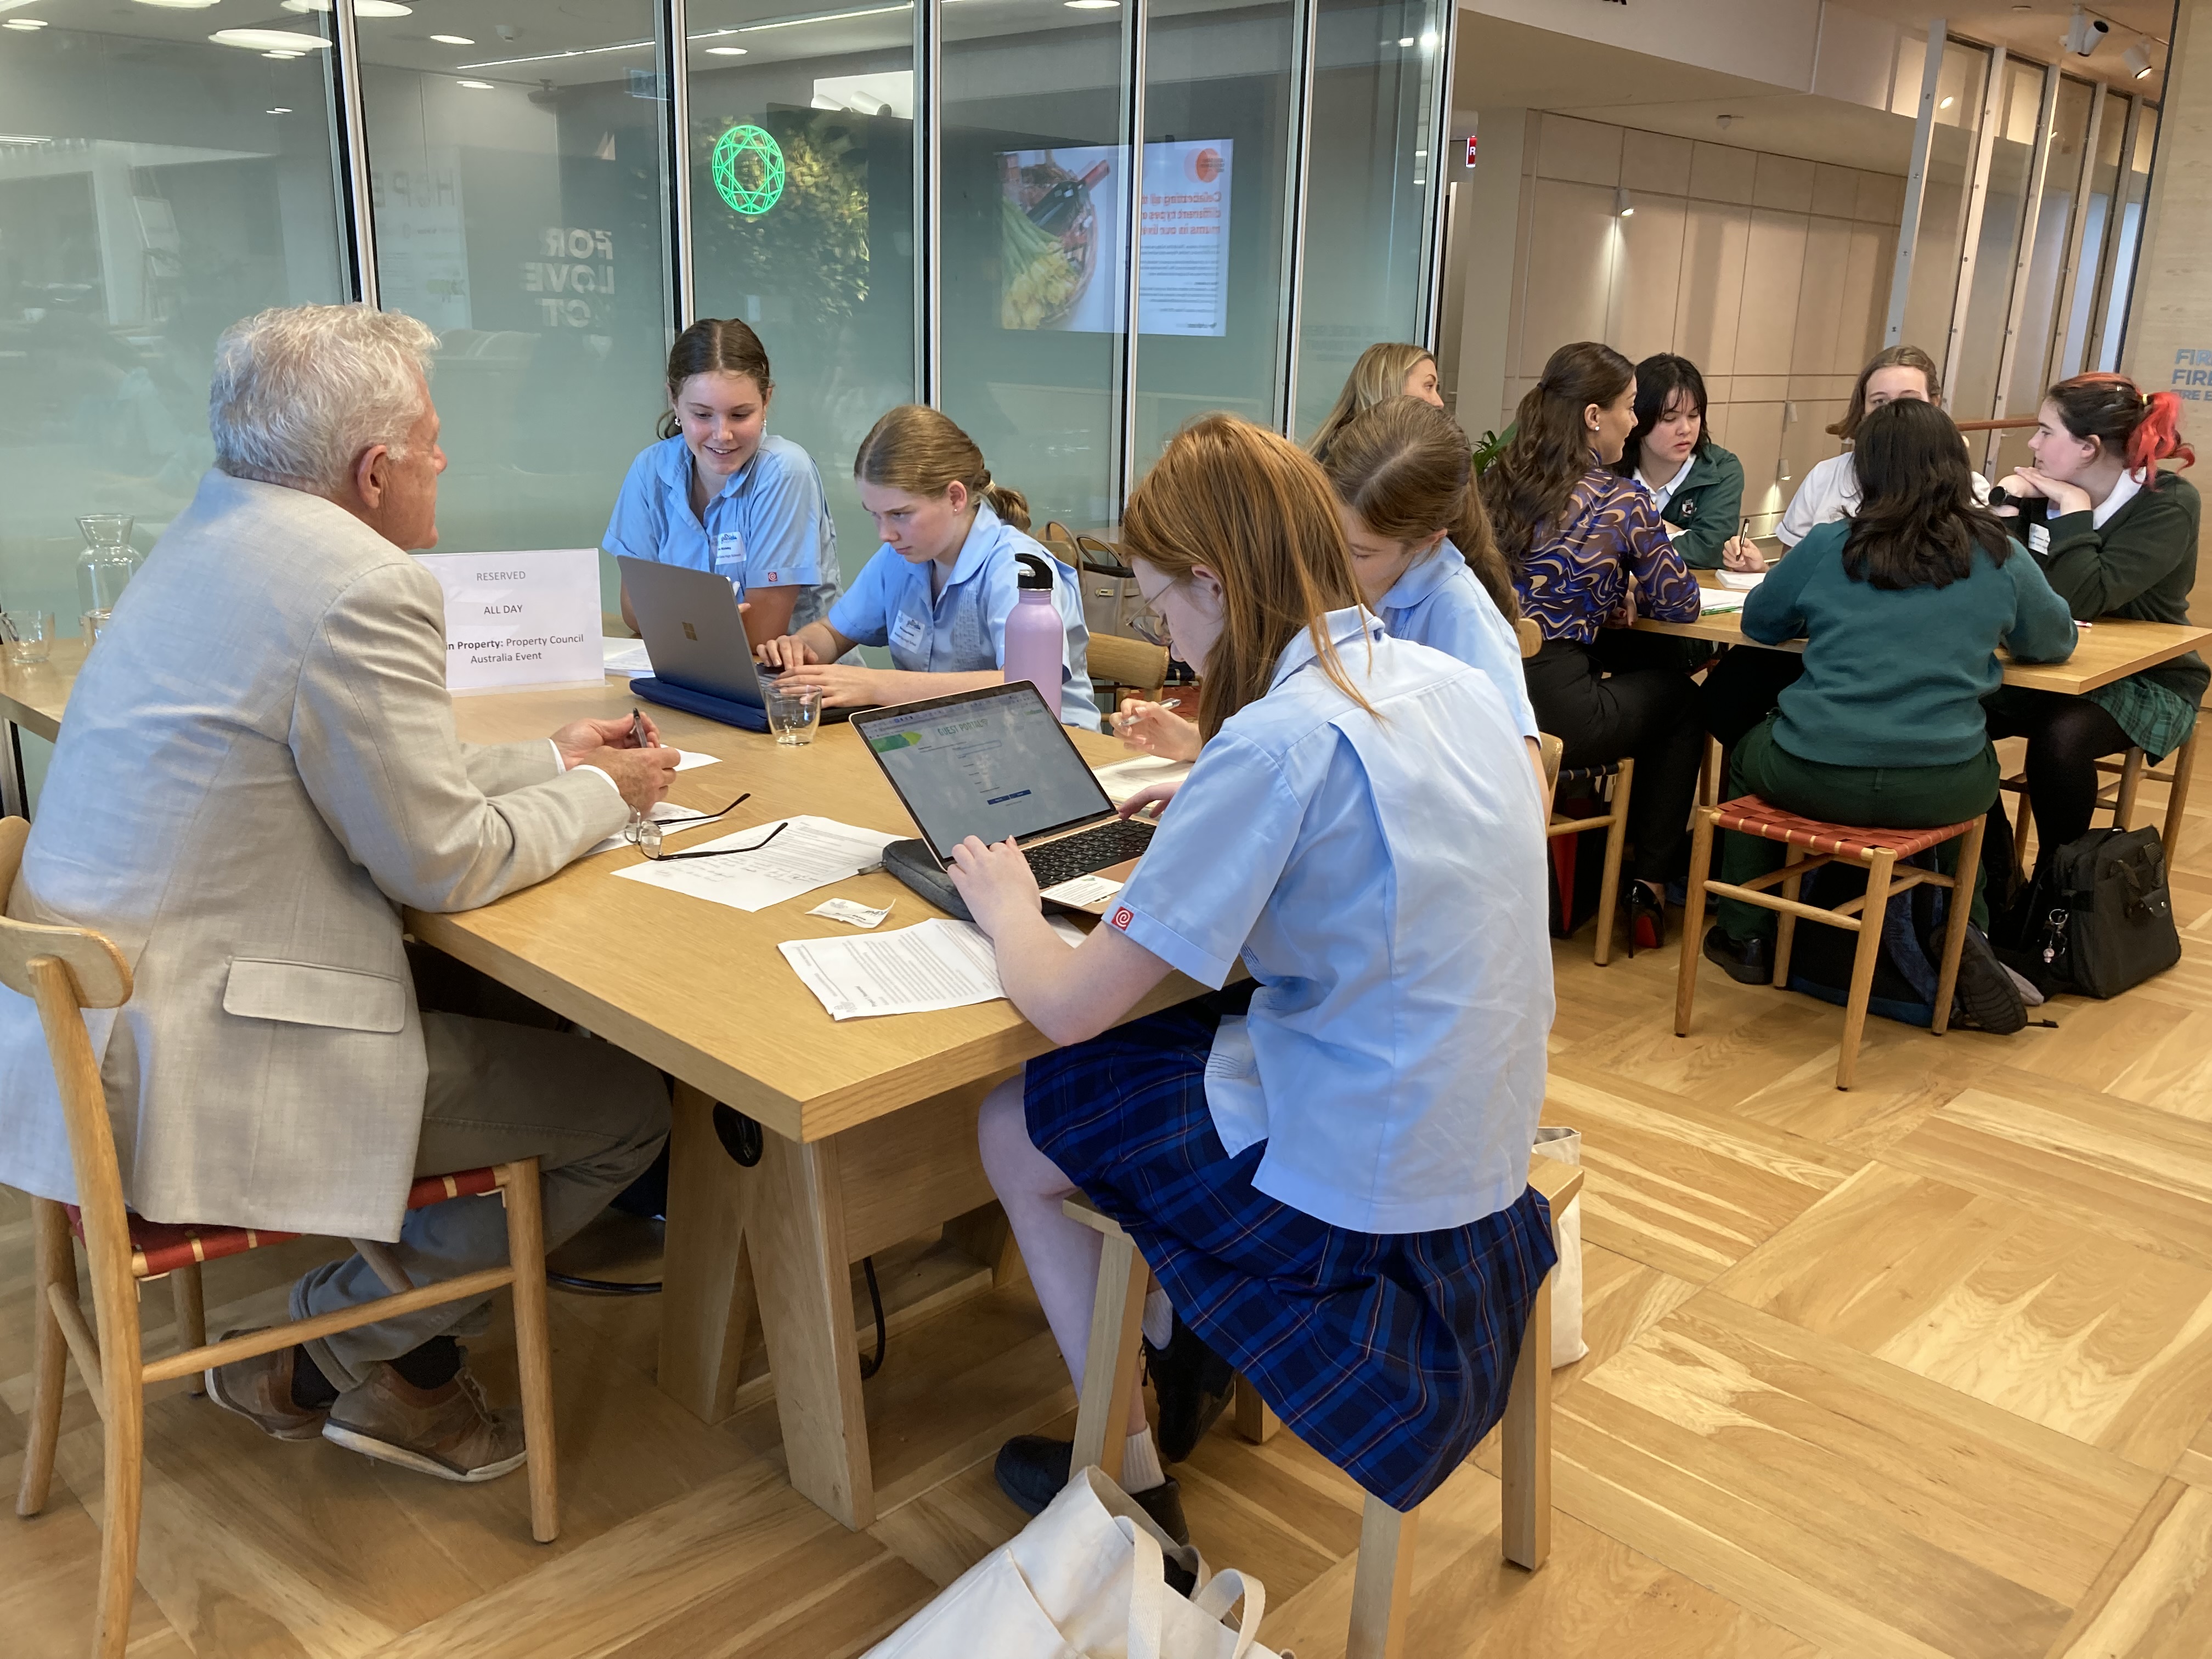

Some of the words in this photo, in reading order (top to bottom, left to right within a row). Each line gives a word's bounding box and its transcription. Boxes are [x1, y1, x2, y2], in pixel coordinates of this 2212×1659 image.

[2175, 349, 2212, 366] FIR
[476, 571, 526, 581] RESERVED
[484, 605, 501, 614] ALL
[504, 605, 523, 613] DAY
[458, 640, 504, 651] Property:
[506, 637, 547, 647] Property
[550, 634, 584, 644] Council
[471, 653, 512, 664] Australia
[516, 652, 542, 661] Event
[937, 725, 959, 736] GUEST
[960, 720, 983, 732] PORTAL
